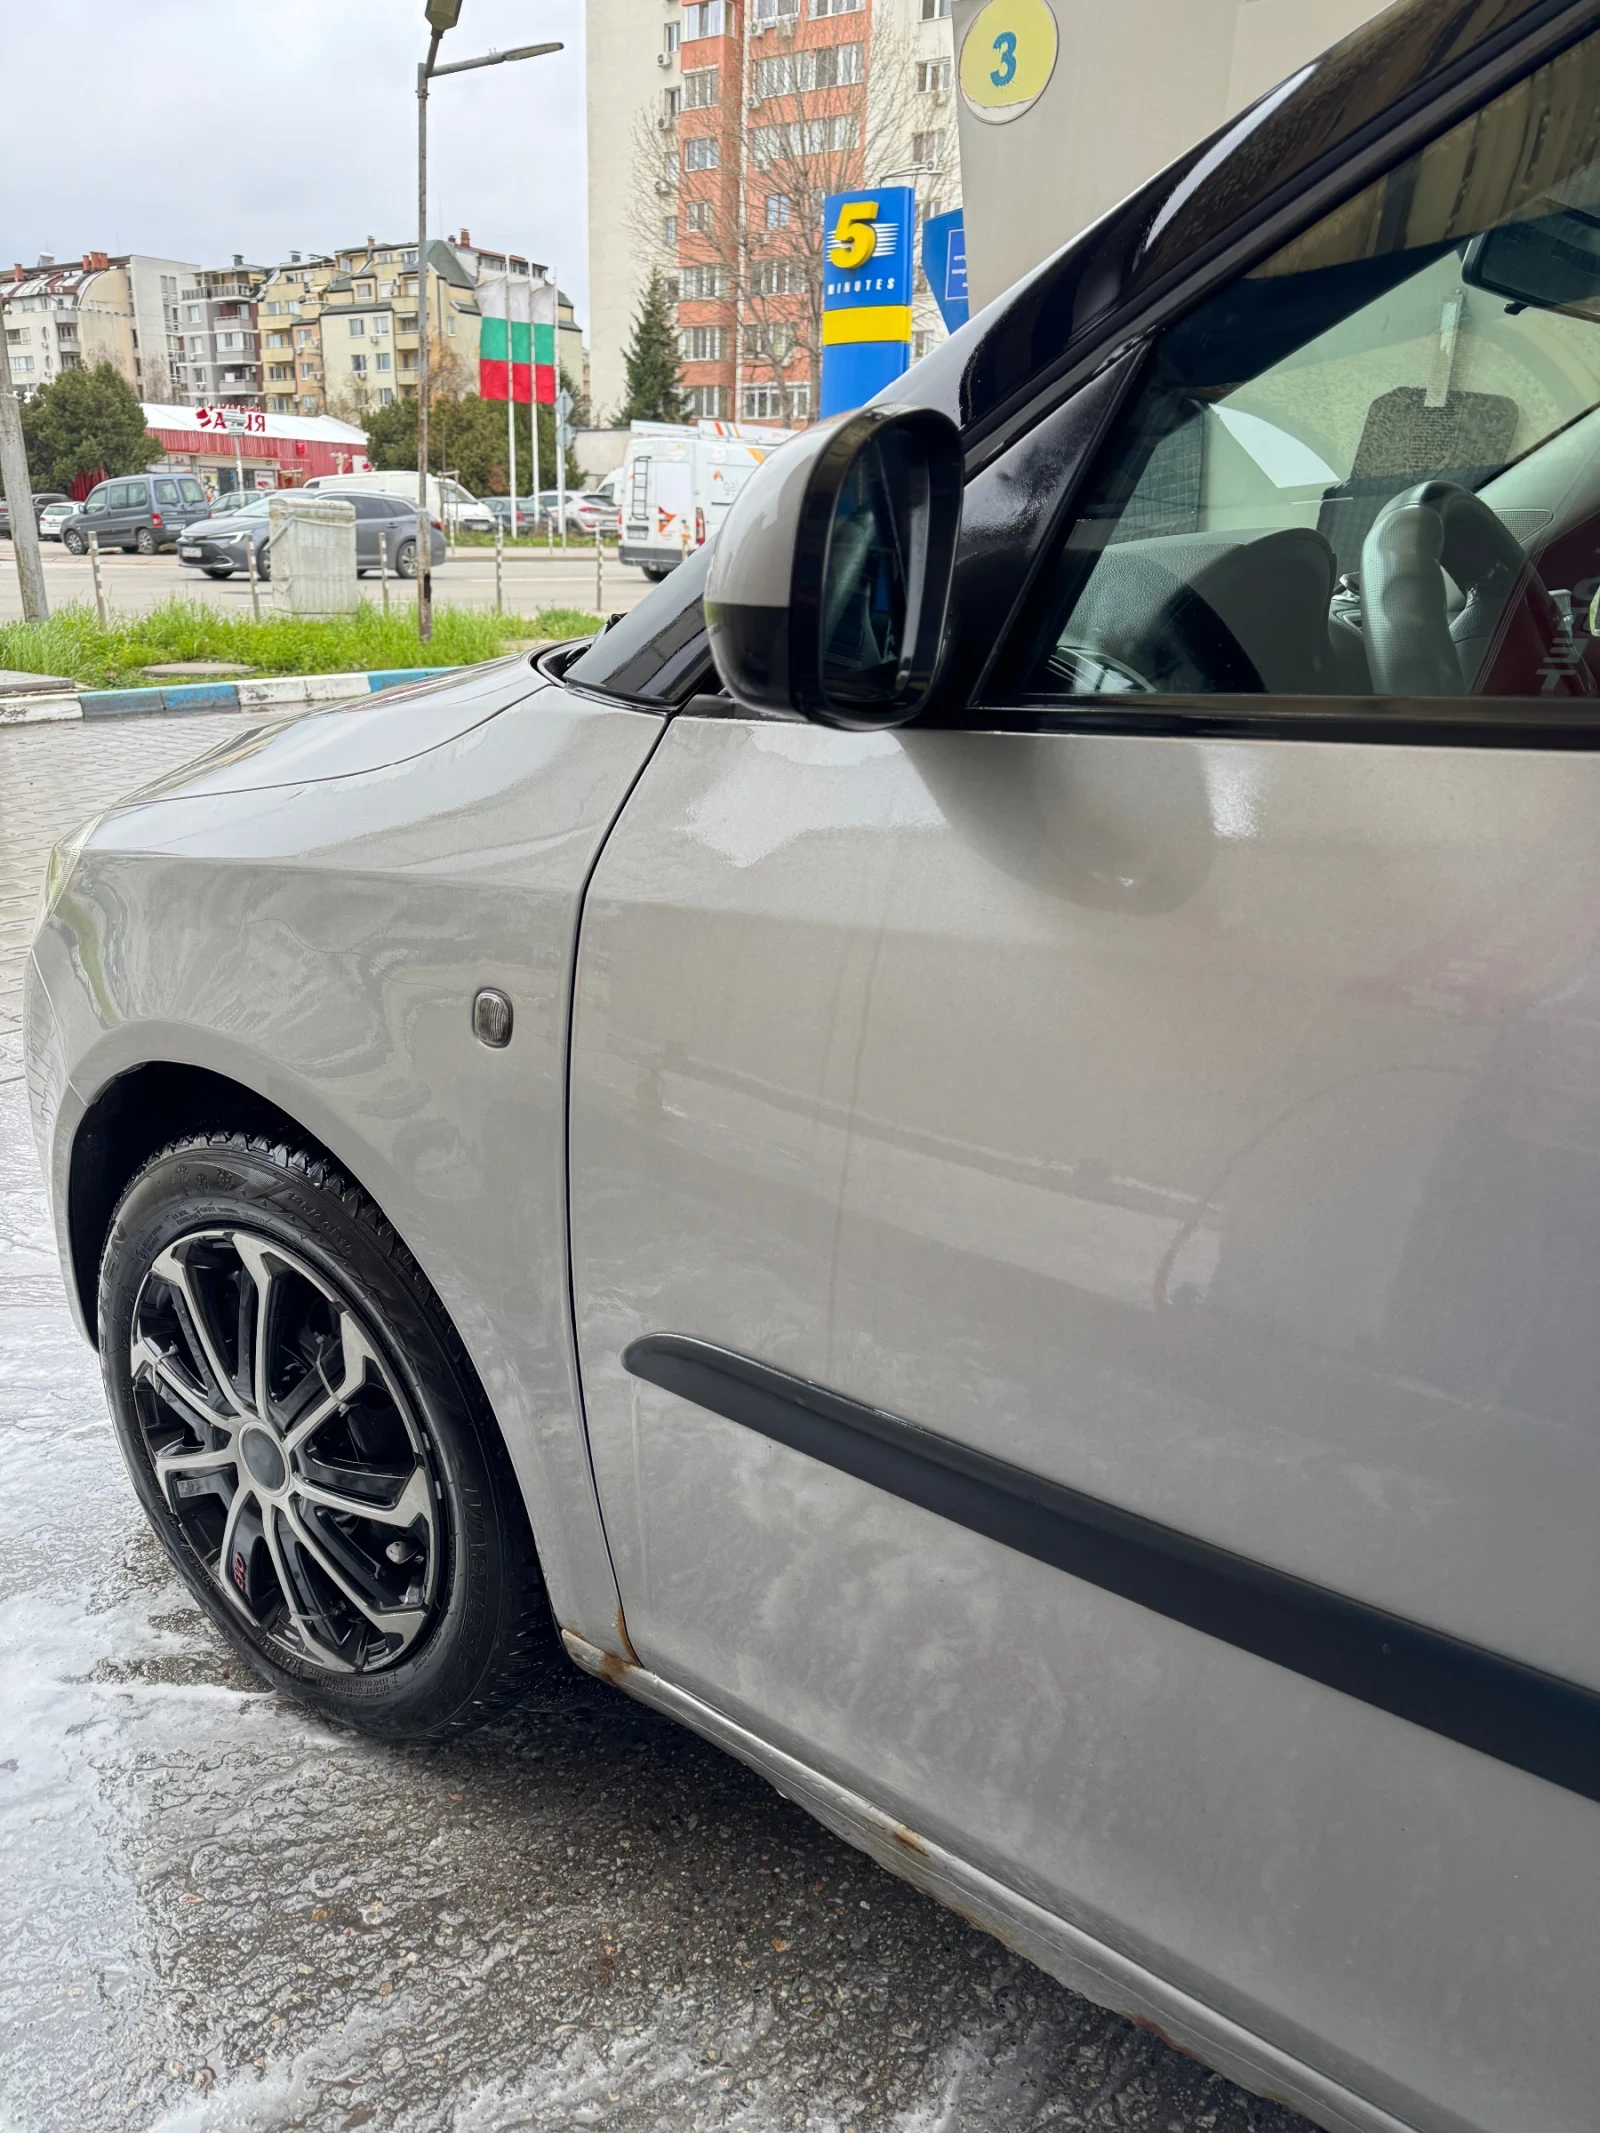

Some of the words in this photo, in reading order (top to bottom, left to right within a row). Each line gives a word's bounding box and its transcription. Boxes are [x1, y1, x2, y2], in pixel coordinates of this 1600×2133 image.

[990, 31, 1017, 87] 3
[829, 201, 879, 269] 5
[827, 277, 895, 295] MINUTES
[233, 1551, 247, 1592] EVO
